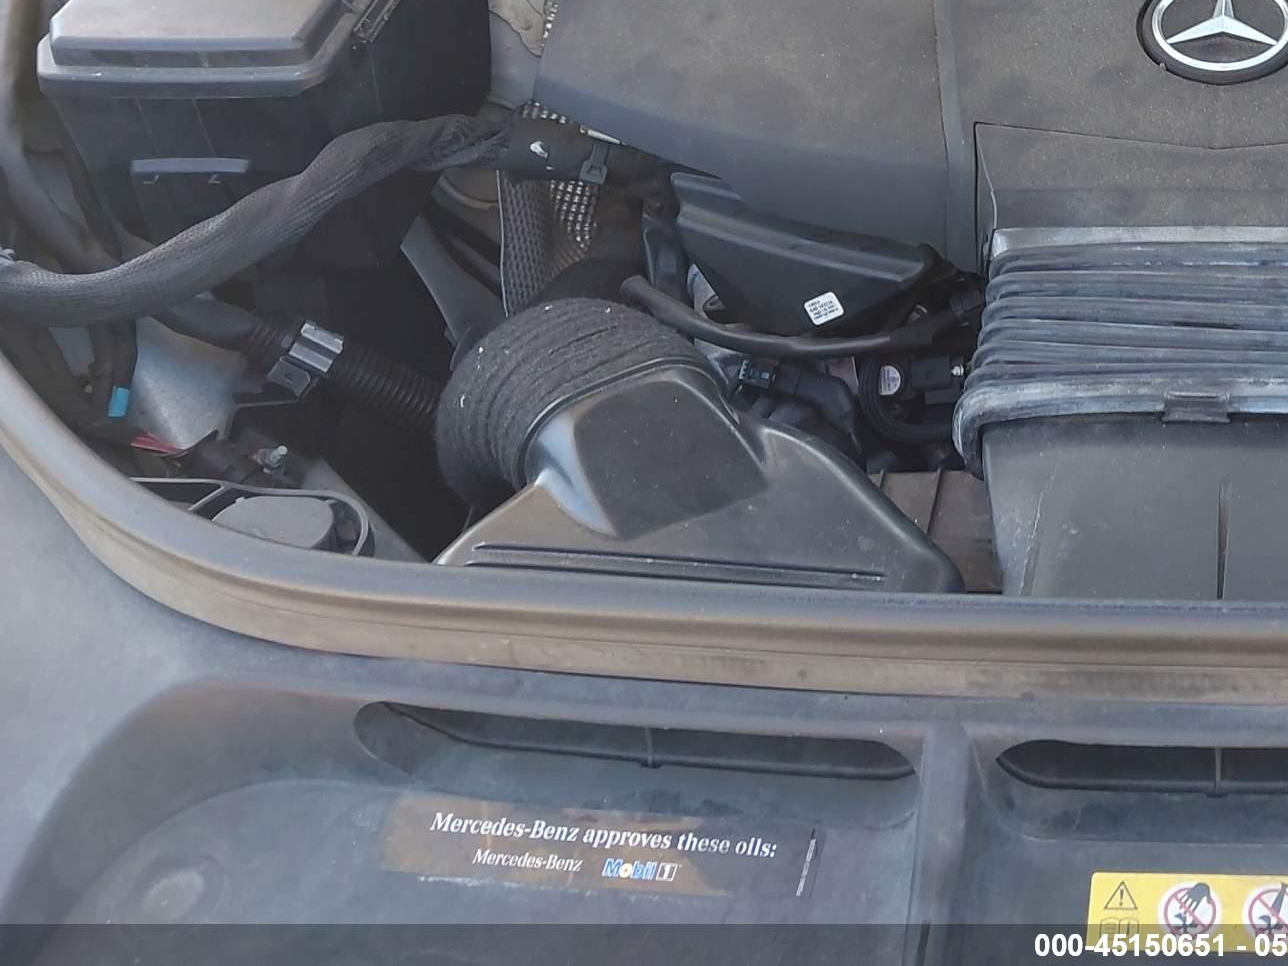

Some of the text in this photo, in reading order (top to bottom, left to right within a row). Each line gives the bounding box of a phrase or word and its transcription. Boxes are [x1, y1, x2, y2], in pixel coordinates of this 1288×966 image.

[430, 812, 777, 858] Mercedes-Benz approves these oils:
[472, 848, 584, 872] Mercedes-Benz
[602, 857, 658, 880] Mobil
